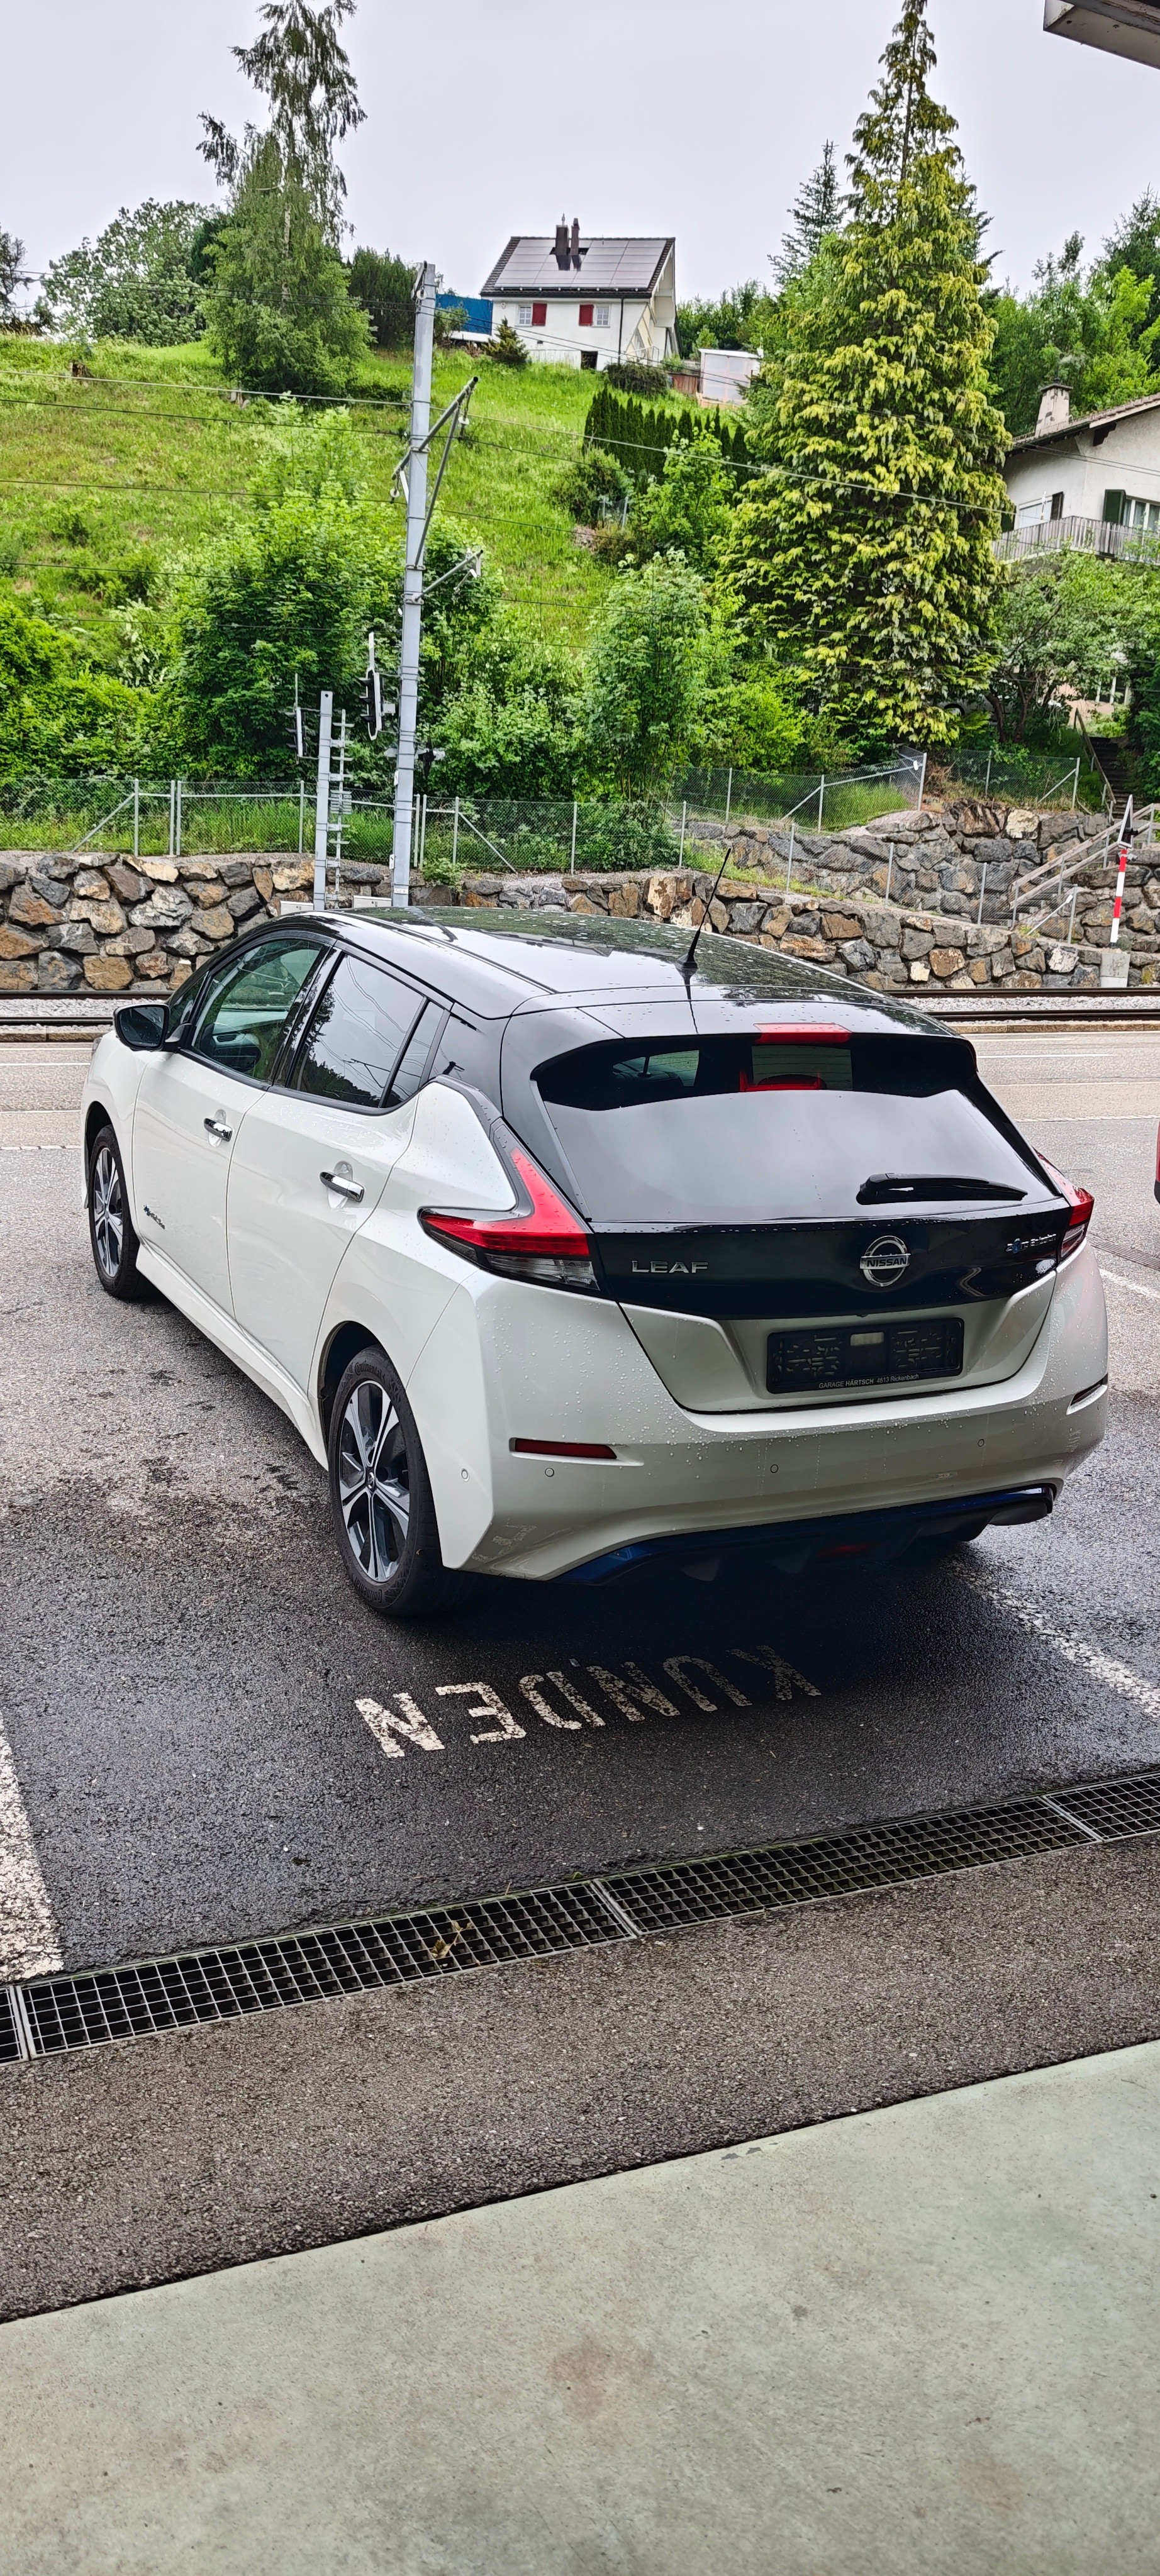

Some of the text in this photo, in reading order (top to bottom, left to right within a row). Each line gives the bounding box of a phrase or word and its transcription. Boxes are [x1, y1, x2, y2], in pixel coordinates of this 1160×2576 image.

[632, 1260, 709, 1274] LEAF
[866, 1257, 906, 1267] NISSAN
[355, 1360, 382, 1380] Continental
[845, 1379, 874, 1387] HÄRTSCH
[890, 1374, 919, 1382] Rickenbach
[354, 1644, 822, 1759] KUNDEN
